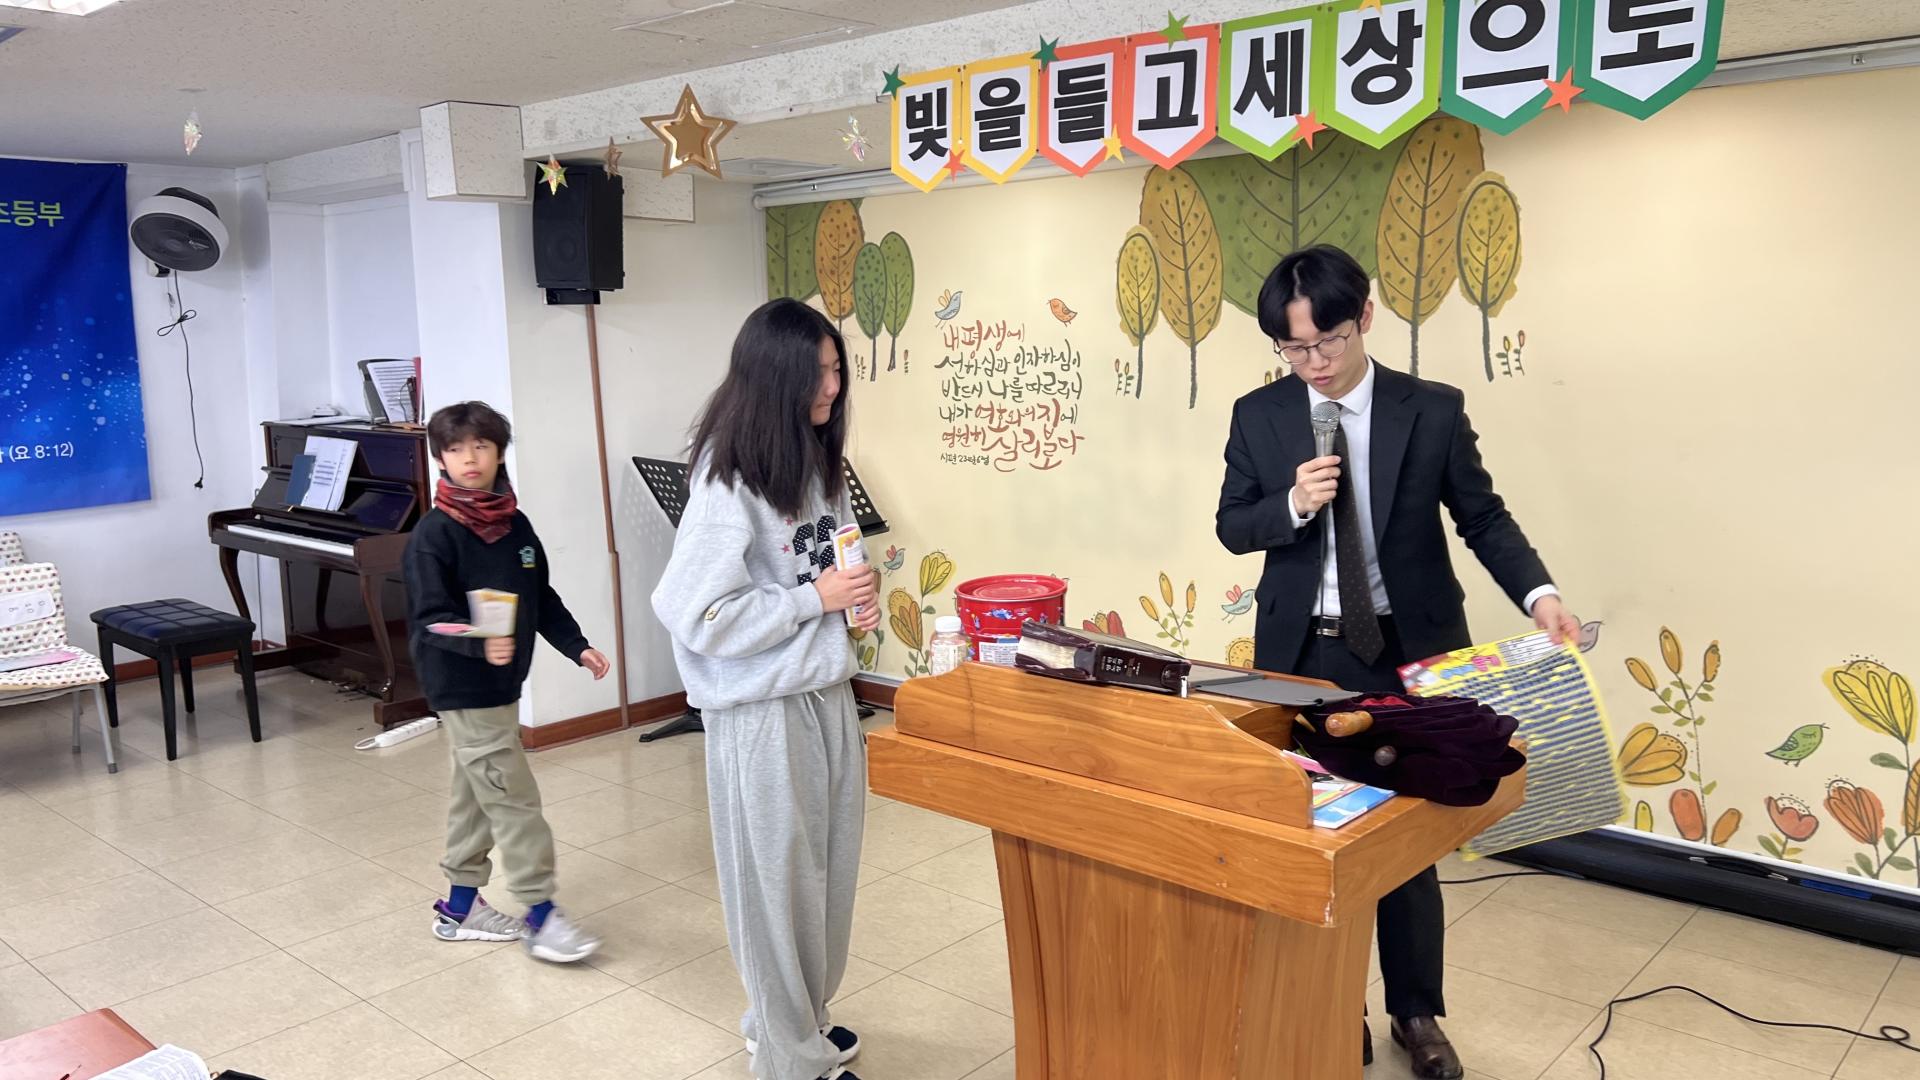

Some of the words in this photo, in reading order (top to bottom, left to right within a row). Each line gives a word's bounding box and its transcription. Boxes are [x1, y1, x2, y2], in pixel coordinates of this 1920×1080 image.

[906, 77, 1026, 161] 빛을
[1054, 48, 1199, 144] 들고
[1233, 0, 1695, 119] 세상으로
[934, 348, 1010, 379] 선하심과
[1013, 338, 1081, 375] 인자하심이
[941, 376, 983, 402] 반드시
[986, 377, 1025, 403] 나를
[1025, 371, 1083, 400] 따르리니
[939, 402, 973, 423] 내가
[974, 400, 1036, 432] 여호와의
[34, 441, 74, 459] 8:12)
[942, 423, 987, 449] 영원히
[980, 427, 1086, 473] 살리로다
